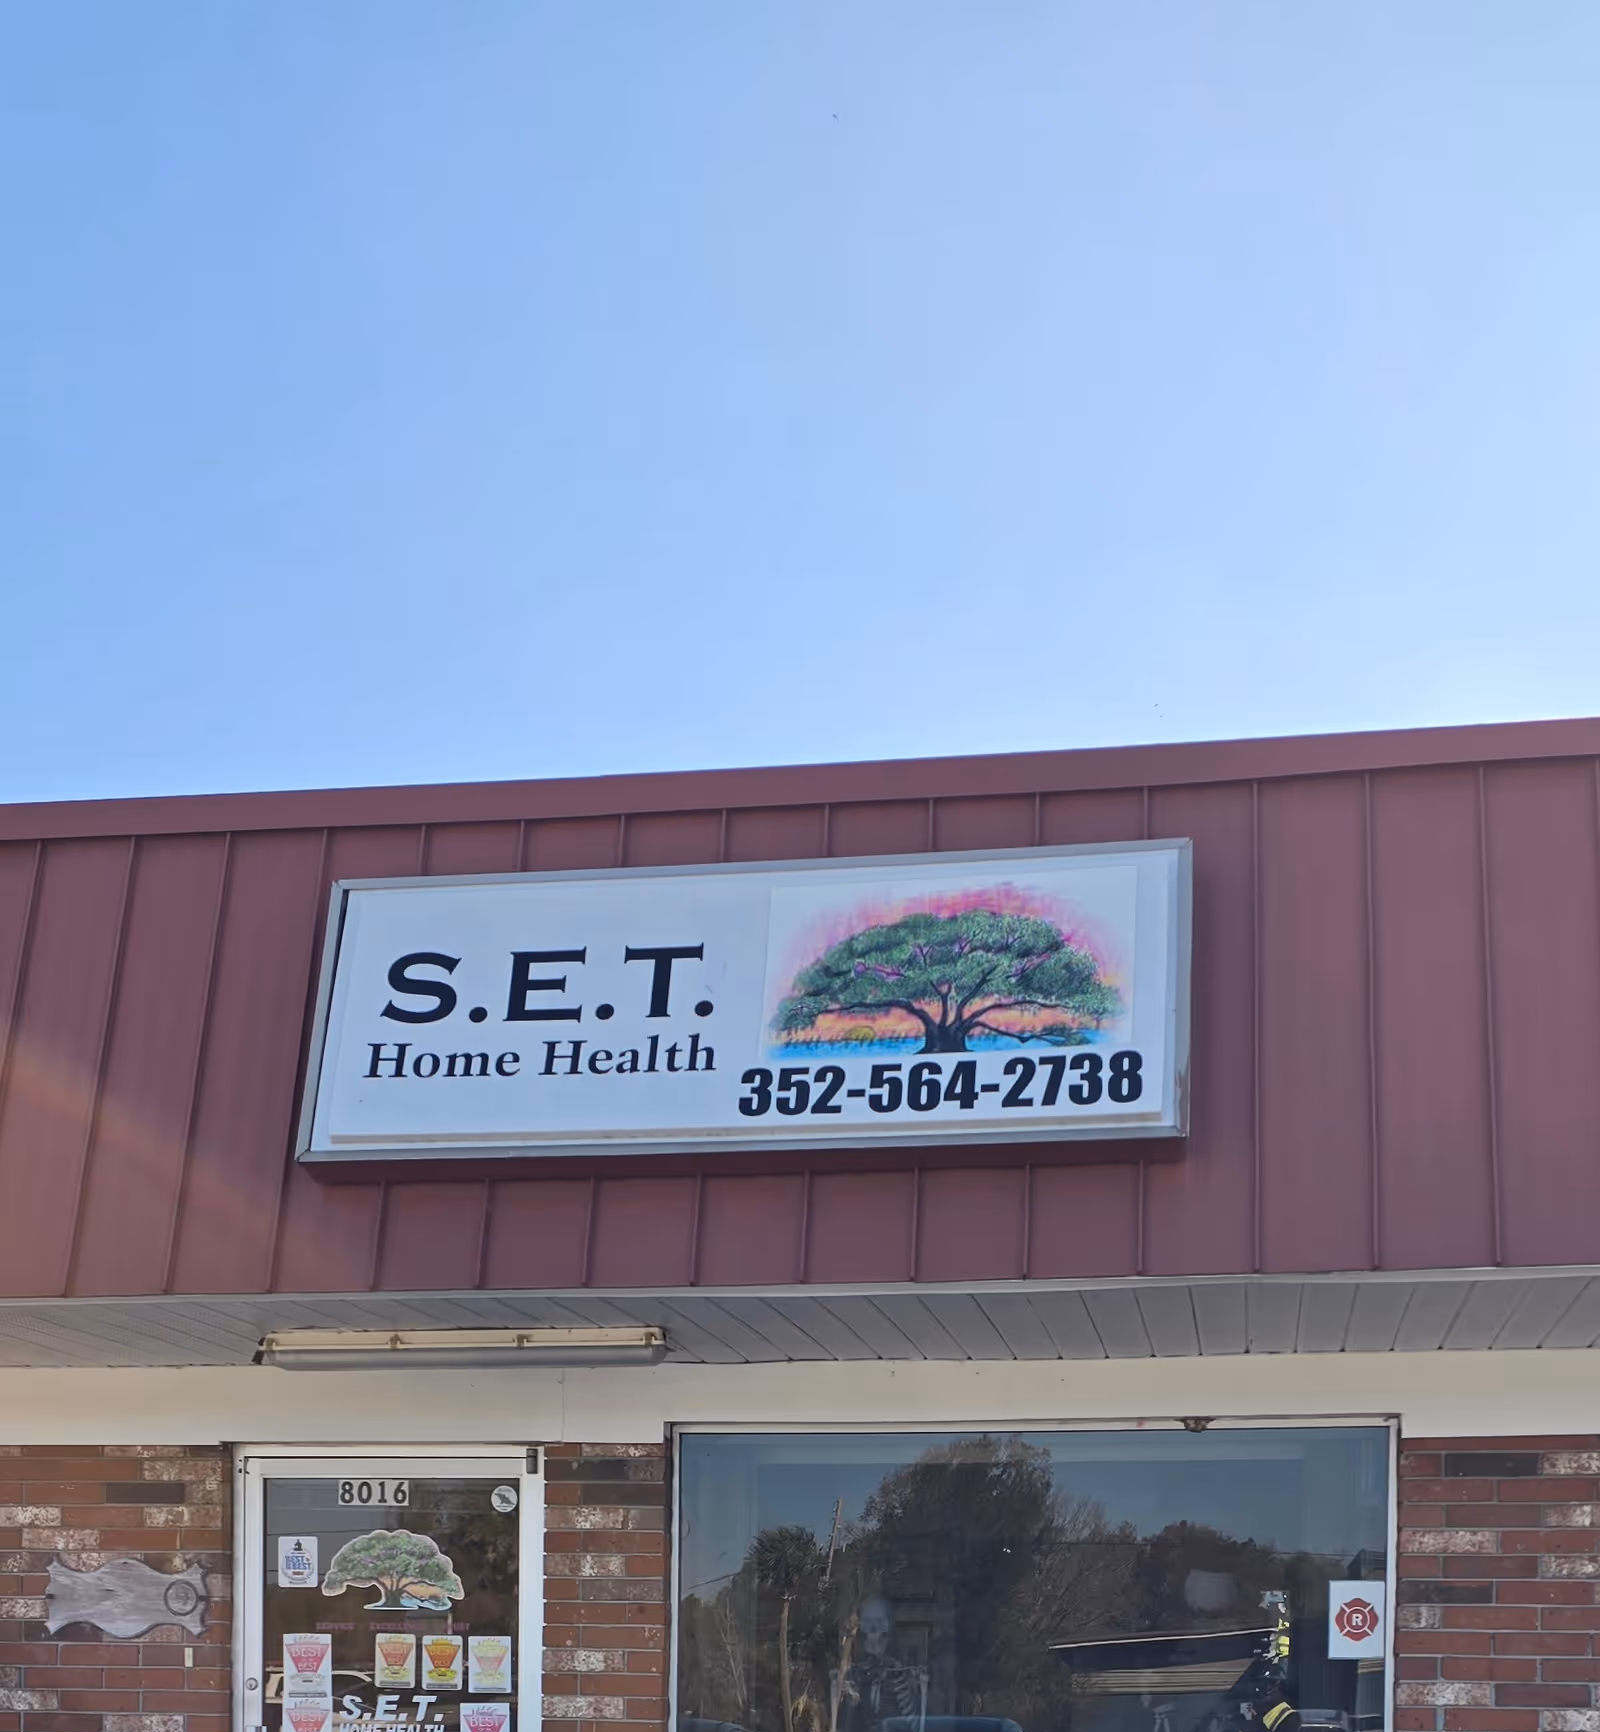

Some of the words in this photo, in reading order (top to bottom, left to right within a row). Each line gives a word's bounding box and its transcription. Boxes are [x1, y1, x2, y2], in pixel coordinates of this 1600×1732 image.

[379, 942, 716, 1026] S.E.T.
[363, 1040, 522, 1080] Home
[538, 1034, 717, 1076] Health
[737, 1050, 1144, 1118] 352-564-2738
[339, 1480, 408, 1504] 8016
[1351, 1613, 1363, 1626] R
[338, 1694, 444, 1722] S.E.T.
[469, 1716, 500, 1727] BEST
